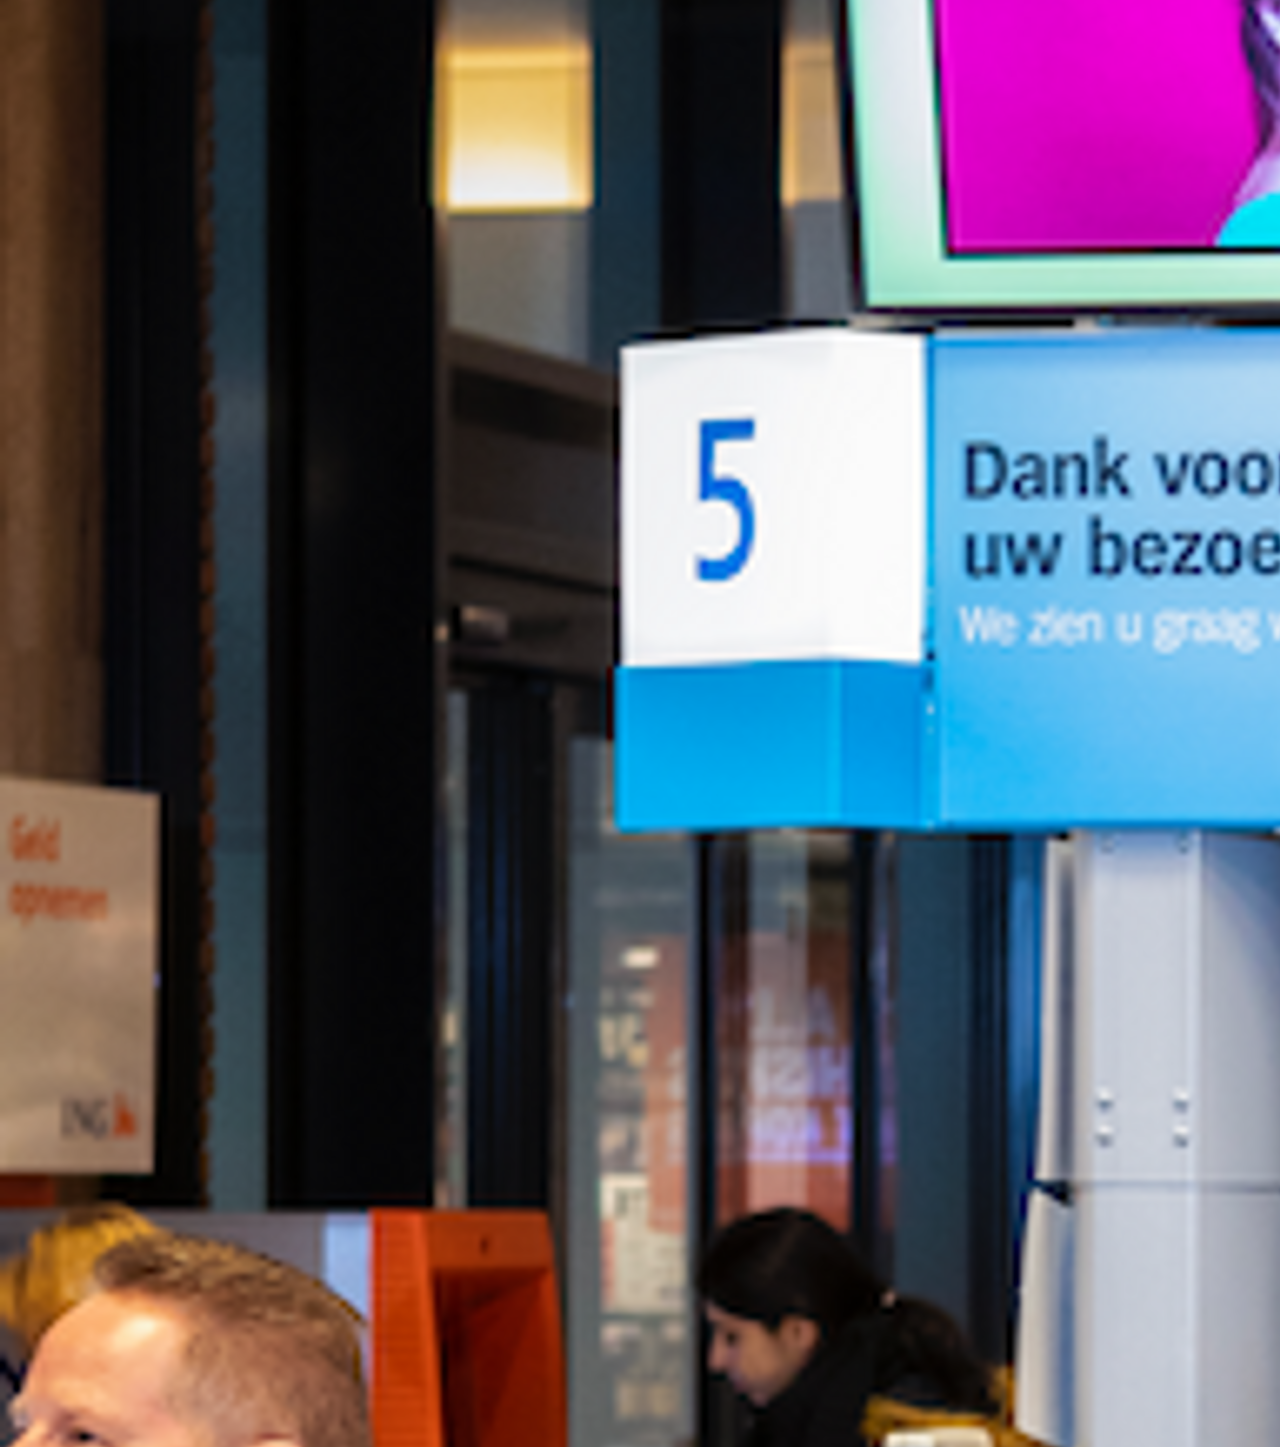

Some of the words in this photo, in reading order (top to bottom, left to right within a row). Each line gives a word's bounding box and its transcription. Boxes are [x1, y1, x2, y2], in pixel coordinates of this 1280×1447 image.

[964, 435, 1131, 500] Dank
[697, 417, 756, 582] 5
[964, 532, 1063, 578] uw
[958, 606, 1019, 645] We
[1028, 606, 1104, 646] zien
[1118, 613, 1142, 642] u
[1153, 609, 1262, 653] graag
[60, 1096, 109, 1140] ING
